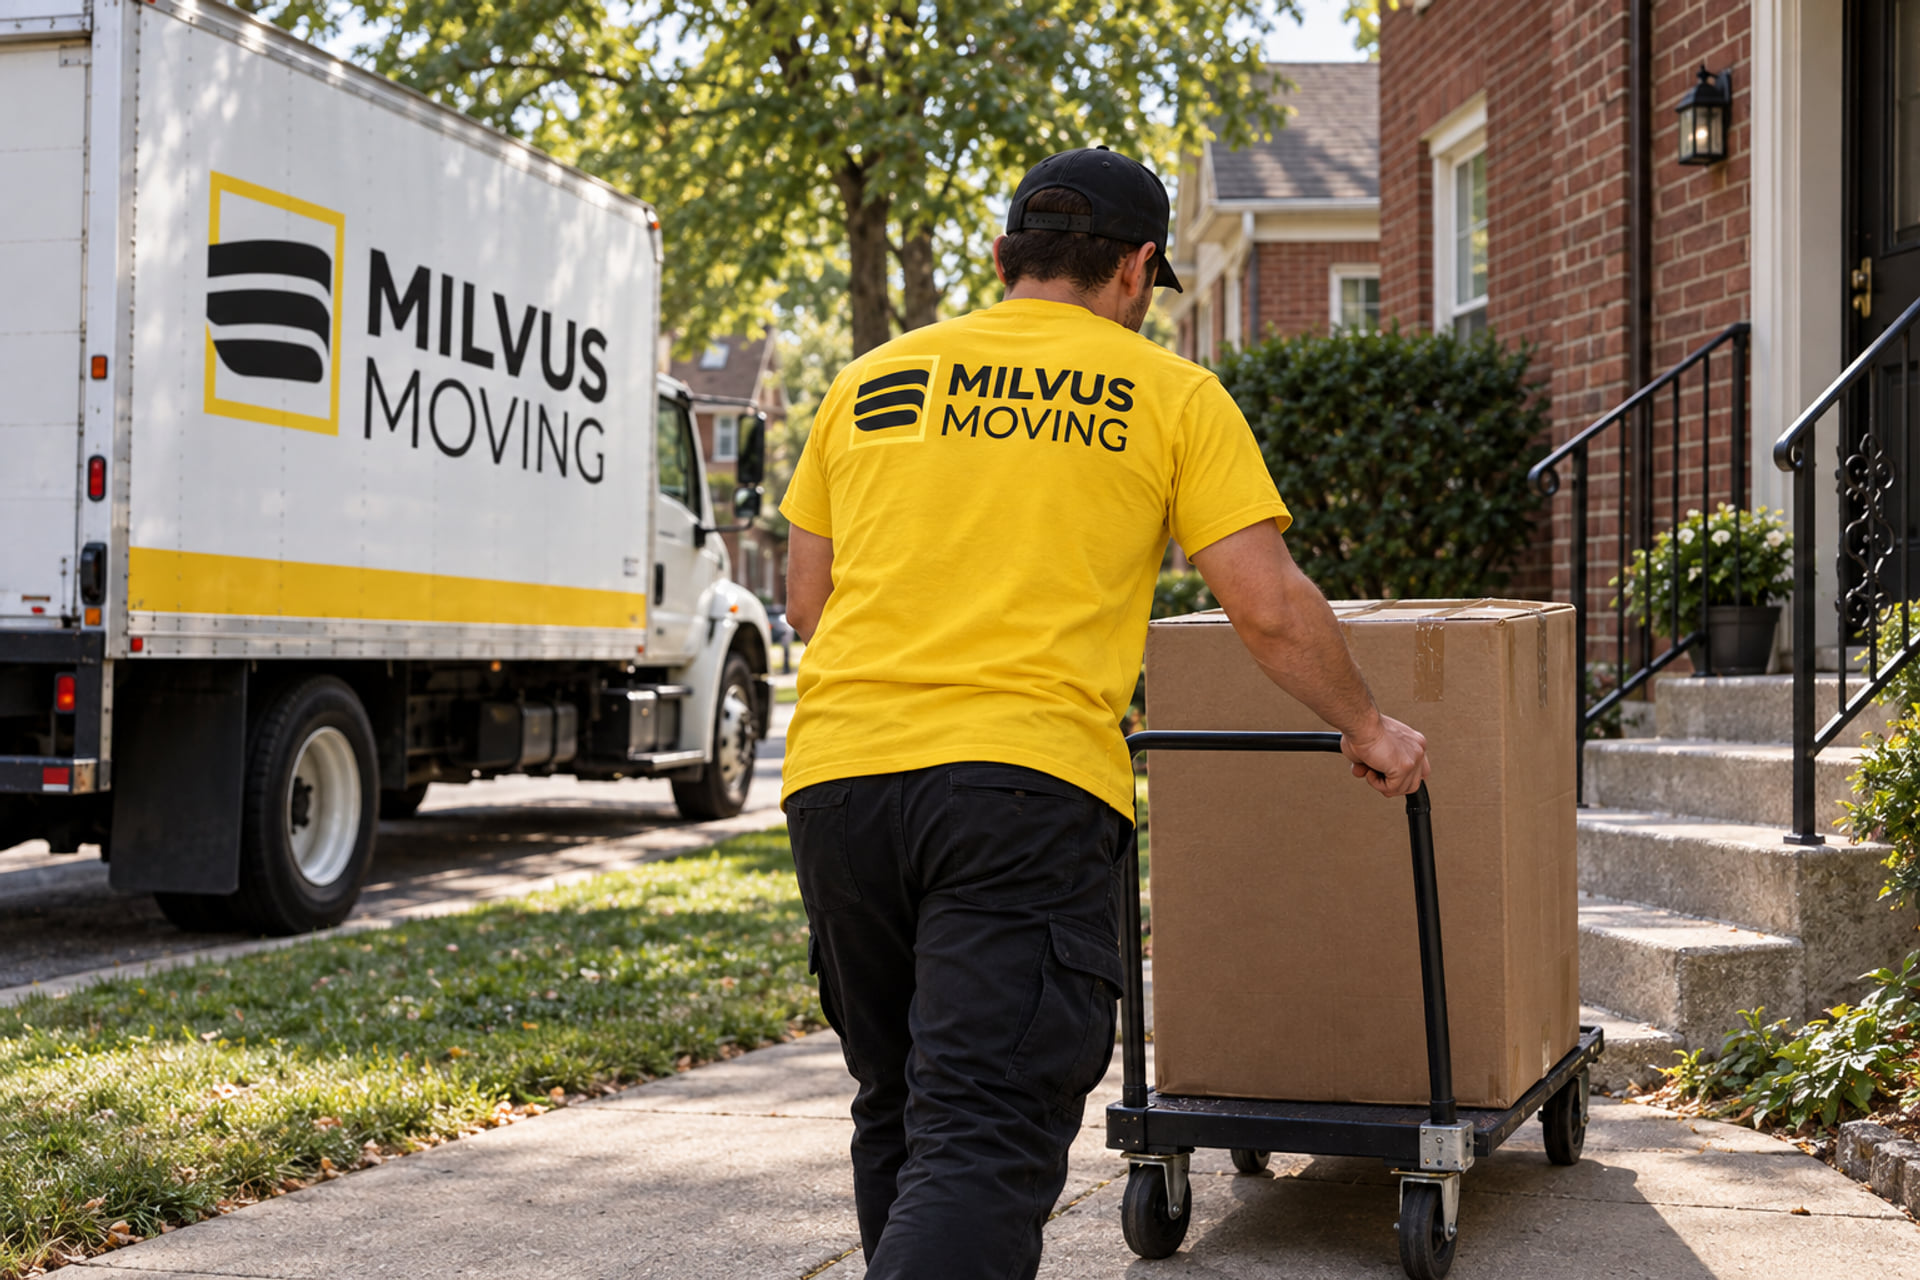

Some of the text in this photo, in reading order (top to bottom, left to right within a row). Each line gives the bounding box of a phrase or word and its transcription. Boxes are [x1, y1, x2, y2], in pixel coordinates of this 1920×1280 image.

[367, 248, 608, 403] MILVUS
[364, 356, 605, 485] MOVING
[941, 403, 1129, 453] MOVING
[947, 363, 1136, 413] MILVUS
